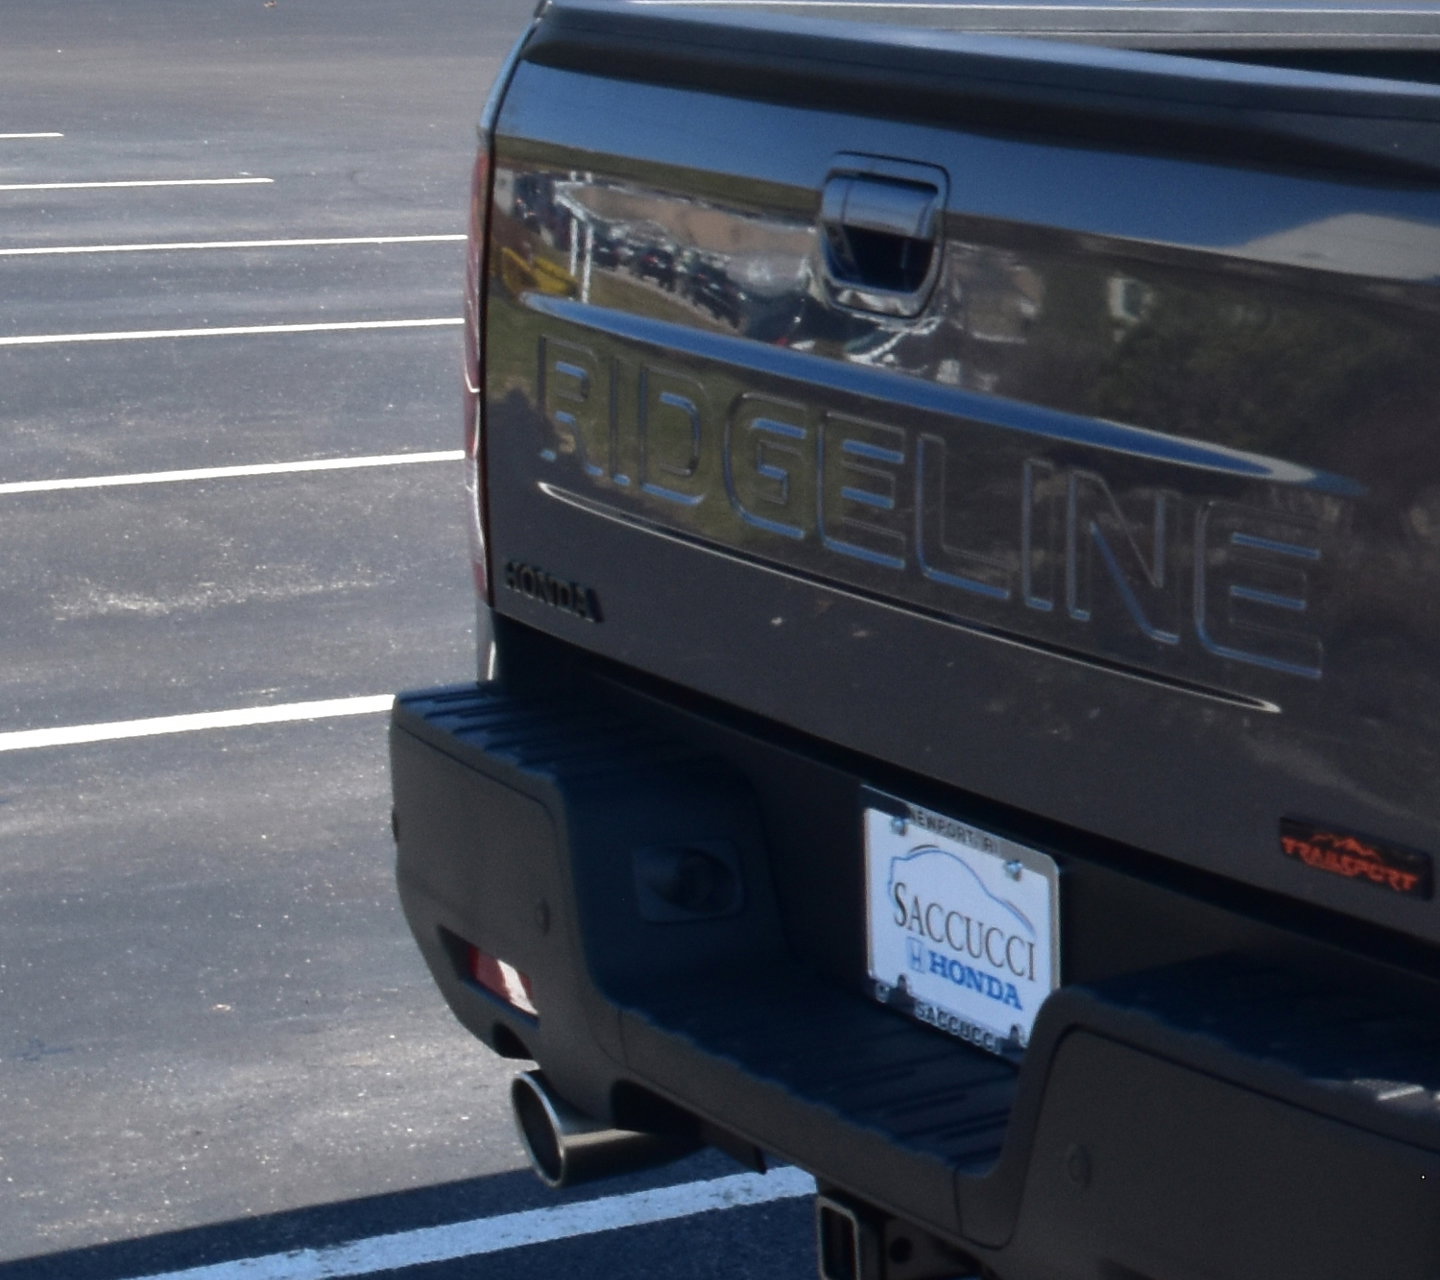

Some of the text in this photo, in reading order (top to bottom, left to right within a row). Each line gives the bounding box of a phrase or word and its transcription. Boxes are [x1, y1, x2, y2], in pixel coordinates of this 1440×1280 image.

[536, 336, 1323, 679] RIDGELINE
[505, 562, 603, 623] HONDA
[1281, 836, 1420, 892] TRAILSPORT
[894, 881, 1035, 982] SACCUCCI
[928, 949, 1024, 1012] HONDA
[914, 998, 1002, 1056] SACCUCCI
